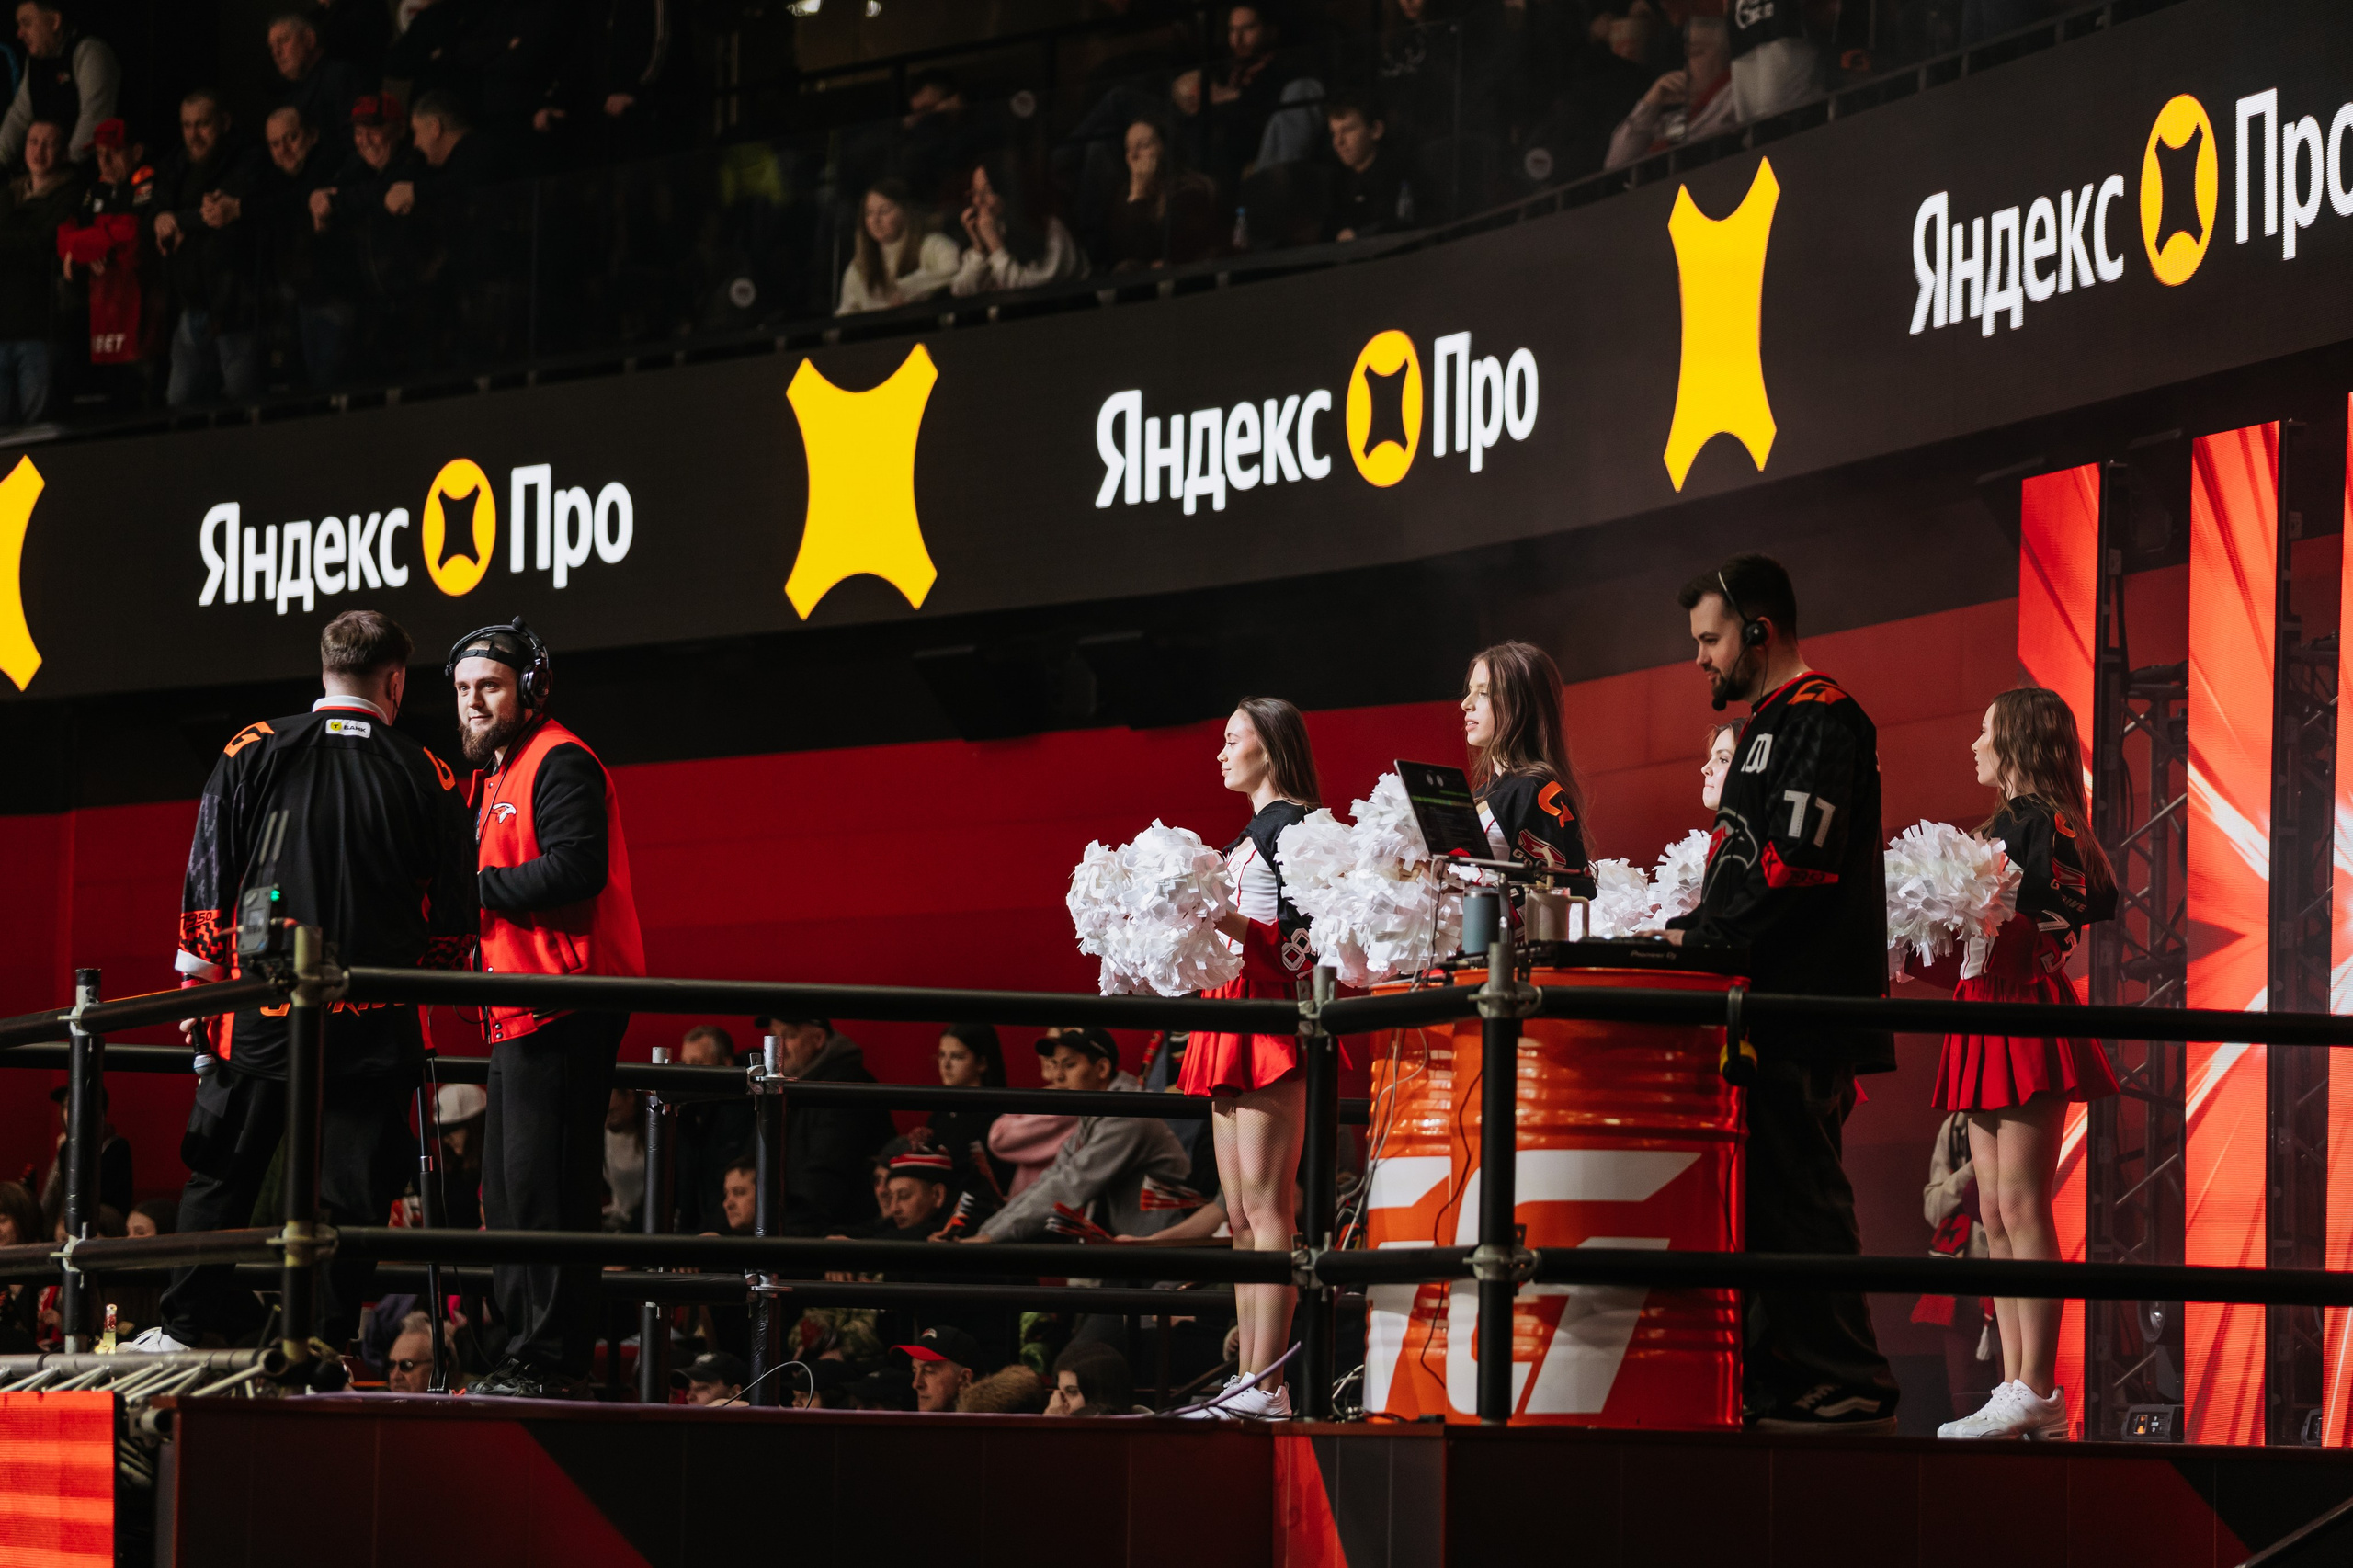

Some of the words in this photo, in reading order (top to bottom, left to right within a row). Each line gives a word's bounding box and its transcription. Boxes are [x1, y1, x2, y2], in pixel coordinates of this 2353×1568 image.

[1909, 173, 2125, 338] Яндекс
[2235, 87, 2353, 261] Про
[1095, 388, 1332, 517] Яндекс
[1433, 330, 1540, 474] Про
[199, 501, 410, 615] Яндекс
[509, 463, 634, 590] Про
[343, 724, 367, 733] БАНК
